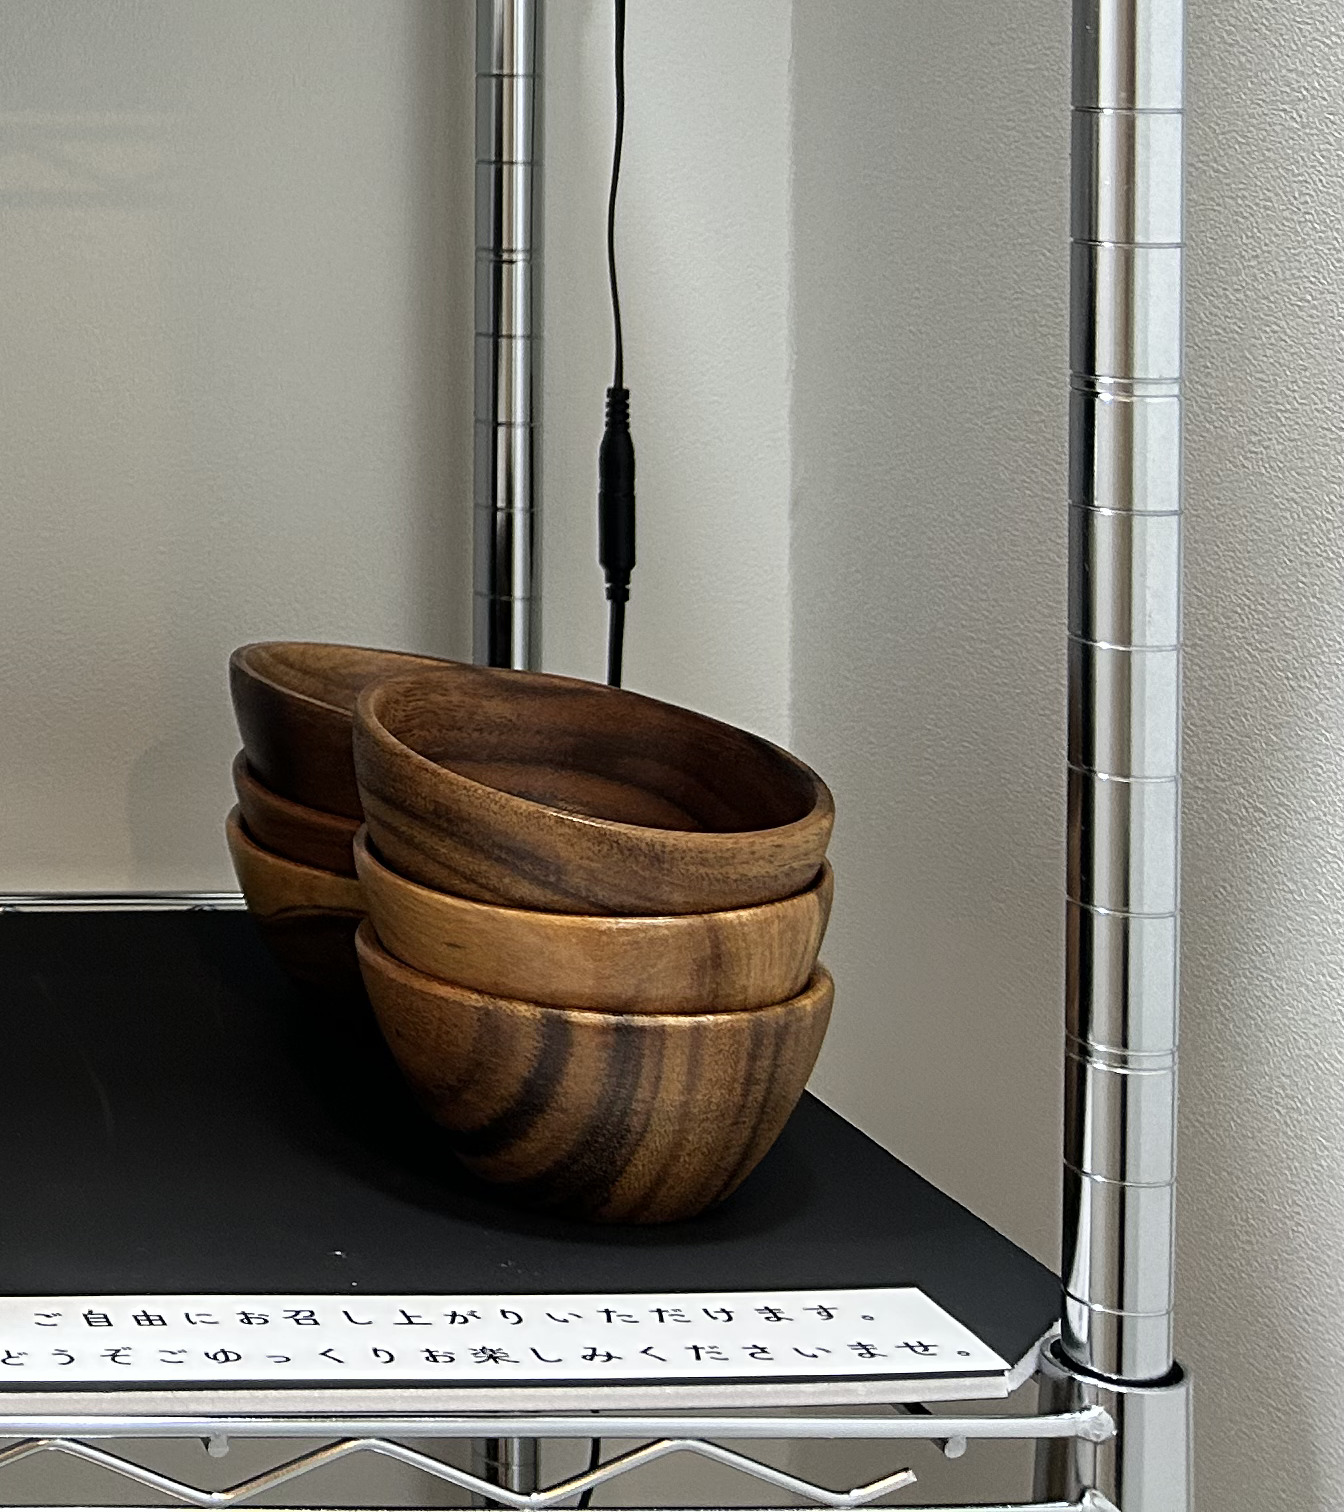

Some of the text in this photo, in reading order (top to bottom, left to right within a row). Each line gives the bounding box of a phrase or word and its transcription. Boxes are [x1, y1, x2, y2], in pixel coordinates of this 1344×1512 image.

[32, 1304, 876, 1328] ご自由にお召し上がりいただけます。
[0, 1339, 973, 1368] どうぞごゆっくりお楽しみくださいませ。
